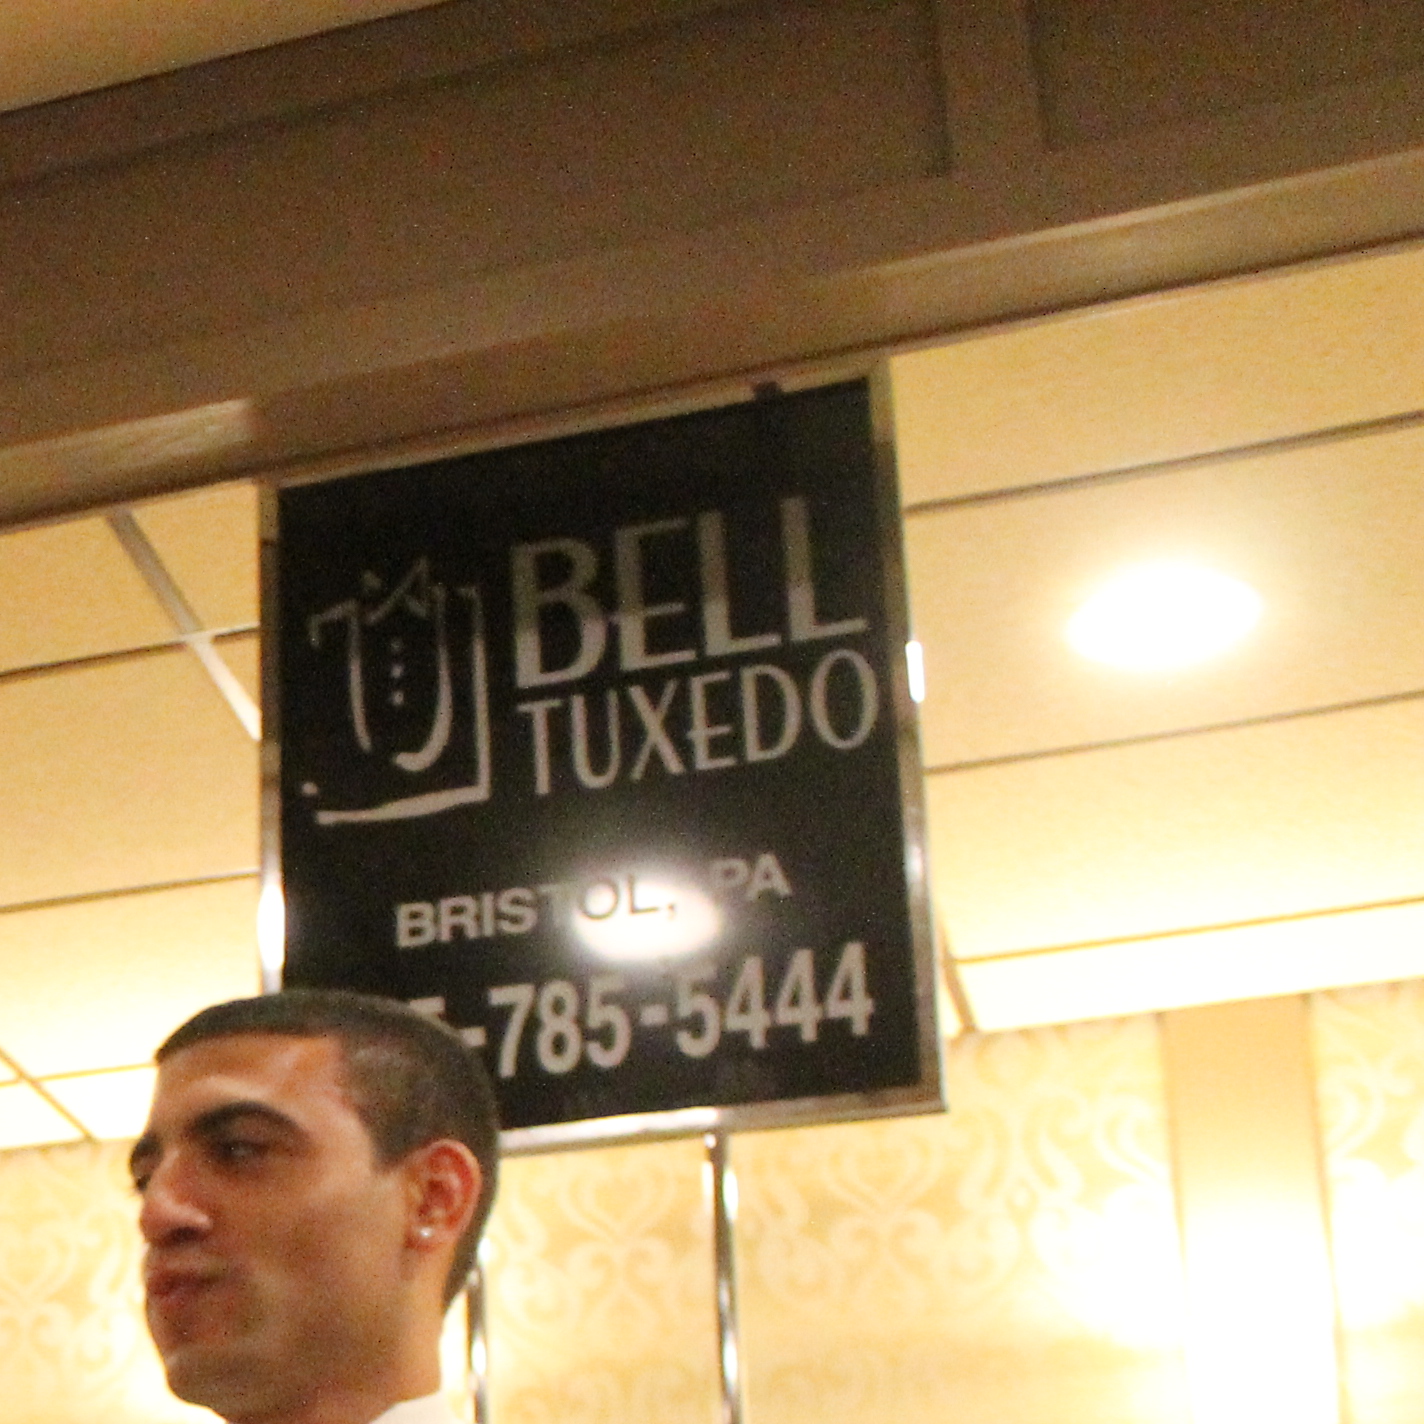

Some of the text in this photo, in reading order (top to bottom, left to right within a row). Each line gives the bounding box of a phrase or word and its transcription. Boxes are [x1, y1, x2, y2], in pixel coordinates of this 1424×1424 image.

[509, 496, 869, 689] BELL
[515, 648, 878, 796] TUXEDO
[709, 852, 792, 901] PA
